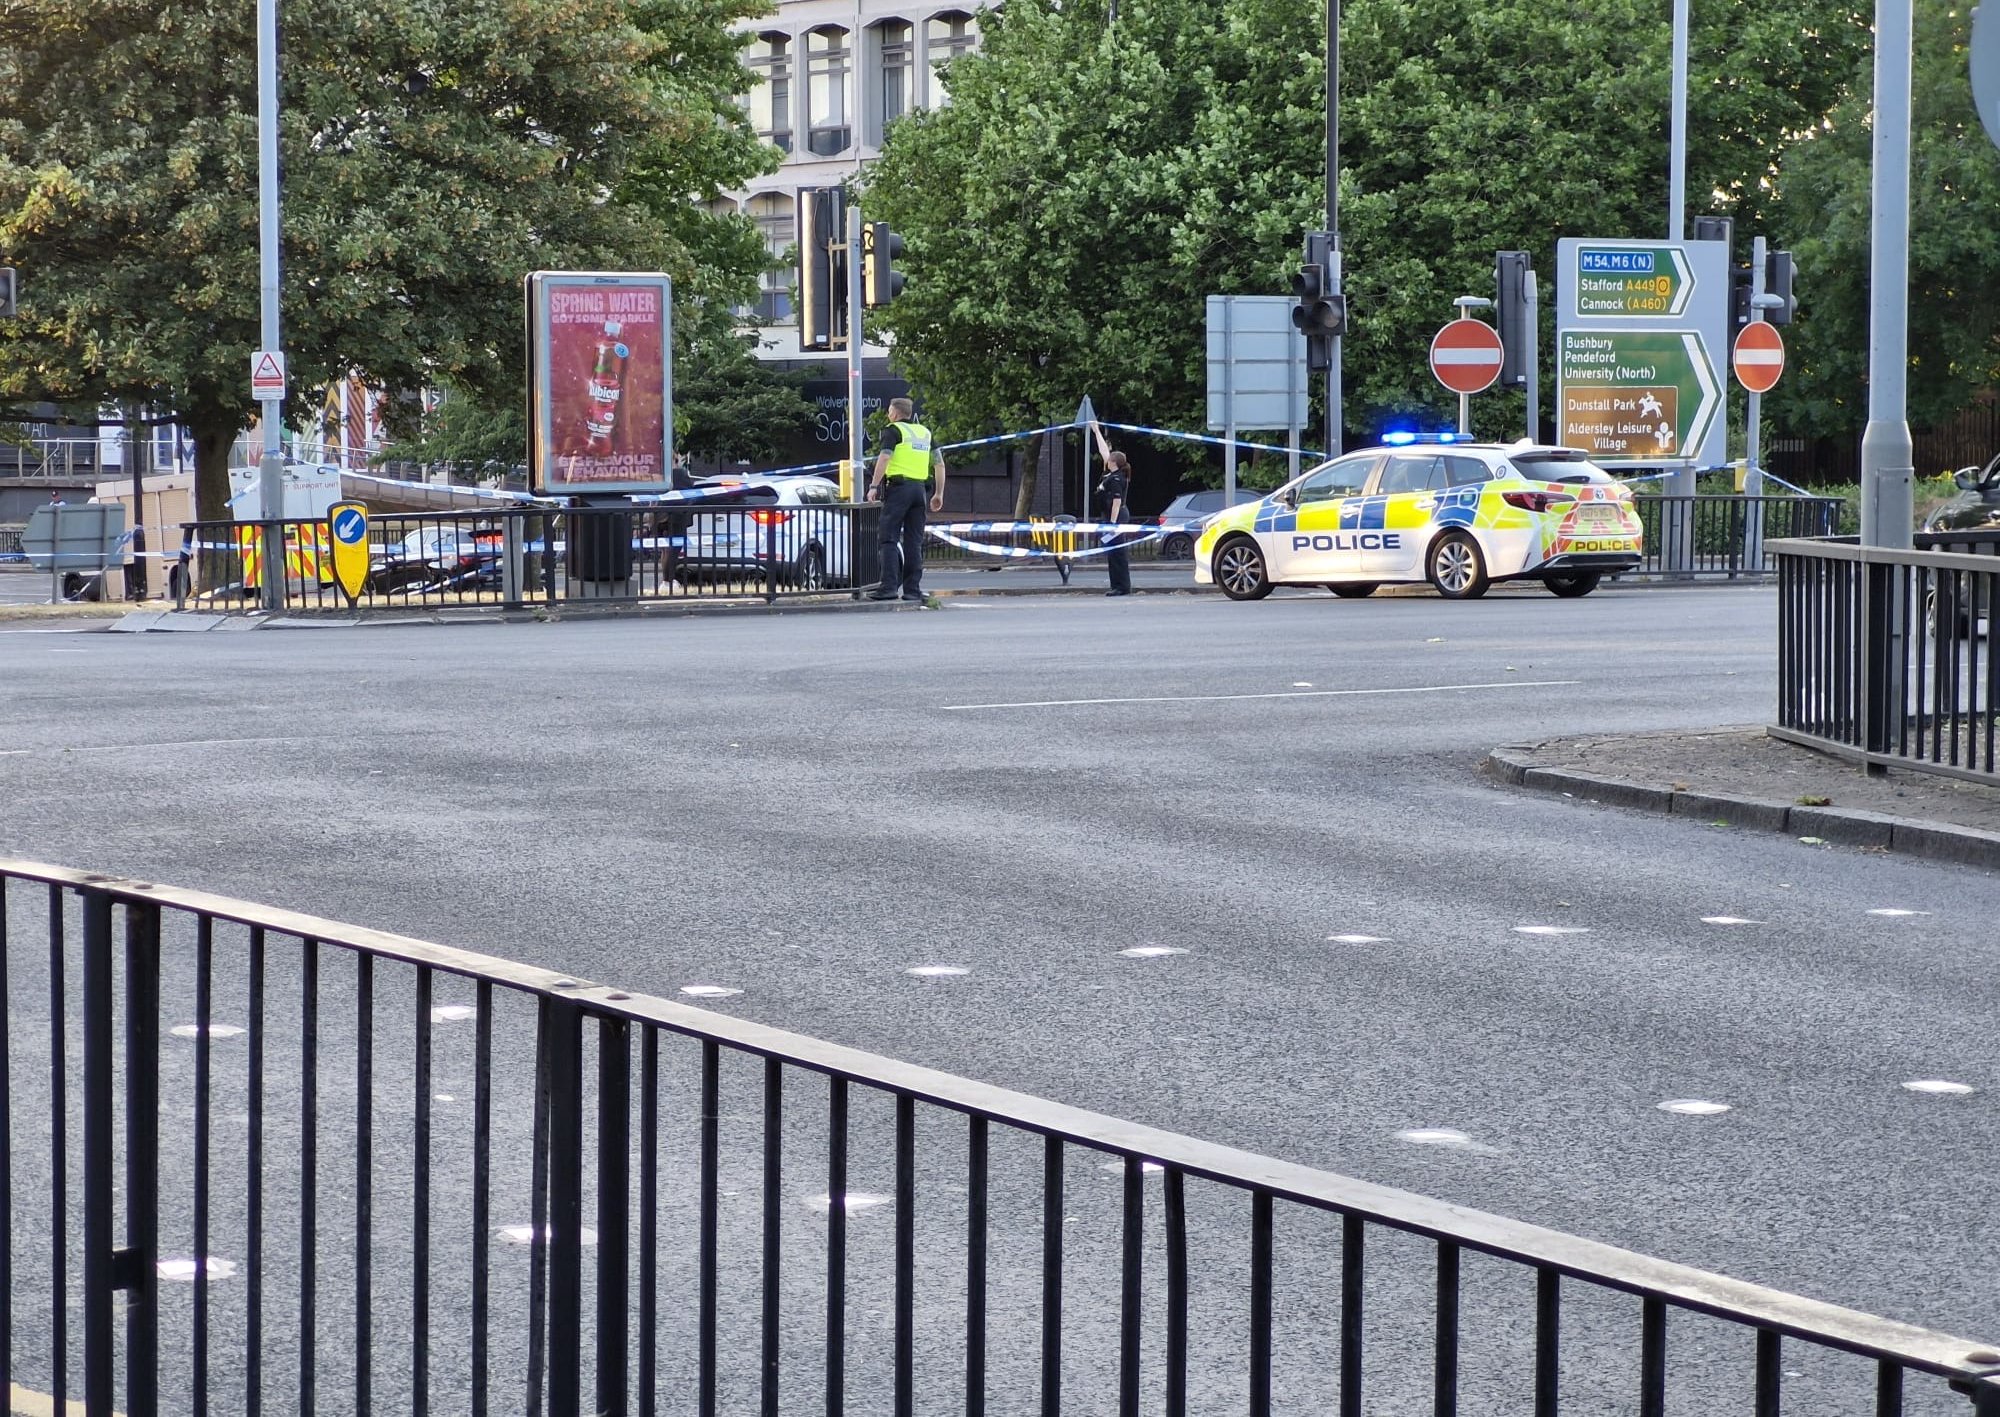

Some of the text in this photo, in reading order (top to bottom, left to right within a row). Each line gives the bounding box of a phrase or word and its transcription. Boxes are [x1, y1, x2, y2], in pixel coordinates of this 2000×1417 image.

[1632, 254, 1652, 269] (N)
[1581, 278, 1655, 291] Stafford A449
[551, 292, 656, 313] SPRING WATER
[1581, 296, 1667, 311] Cannock (A460)
[551, 313, 655, 324] GOT SOME SPARKLE
[1566, 336, 1613, 350] Bushbury
[1565, 351, 1616, 363] Pendeford
[1564, 365, 1656, 381] University (North)
[815, 395, 882, 410] Wolverhpton
[1568, 398, 1636, 411] Dunstall Park
[1567, 421, 1652, 436] Aldersley Leisure
[1593, 437, 1627, 450] Village
[585, 454, 655, 466] FLAVOUR
[293, 482, 322, 490] SUPPORT
[1292, 533, 1401, 552] POLICE
[1575, 540, 1632, 552] POLICE
